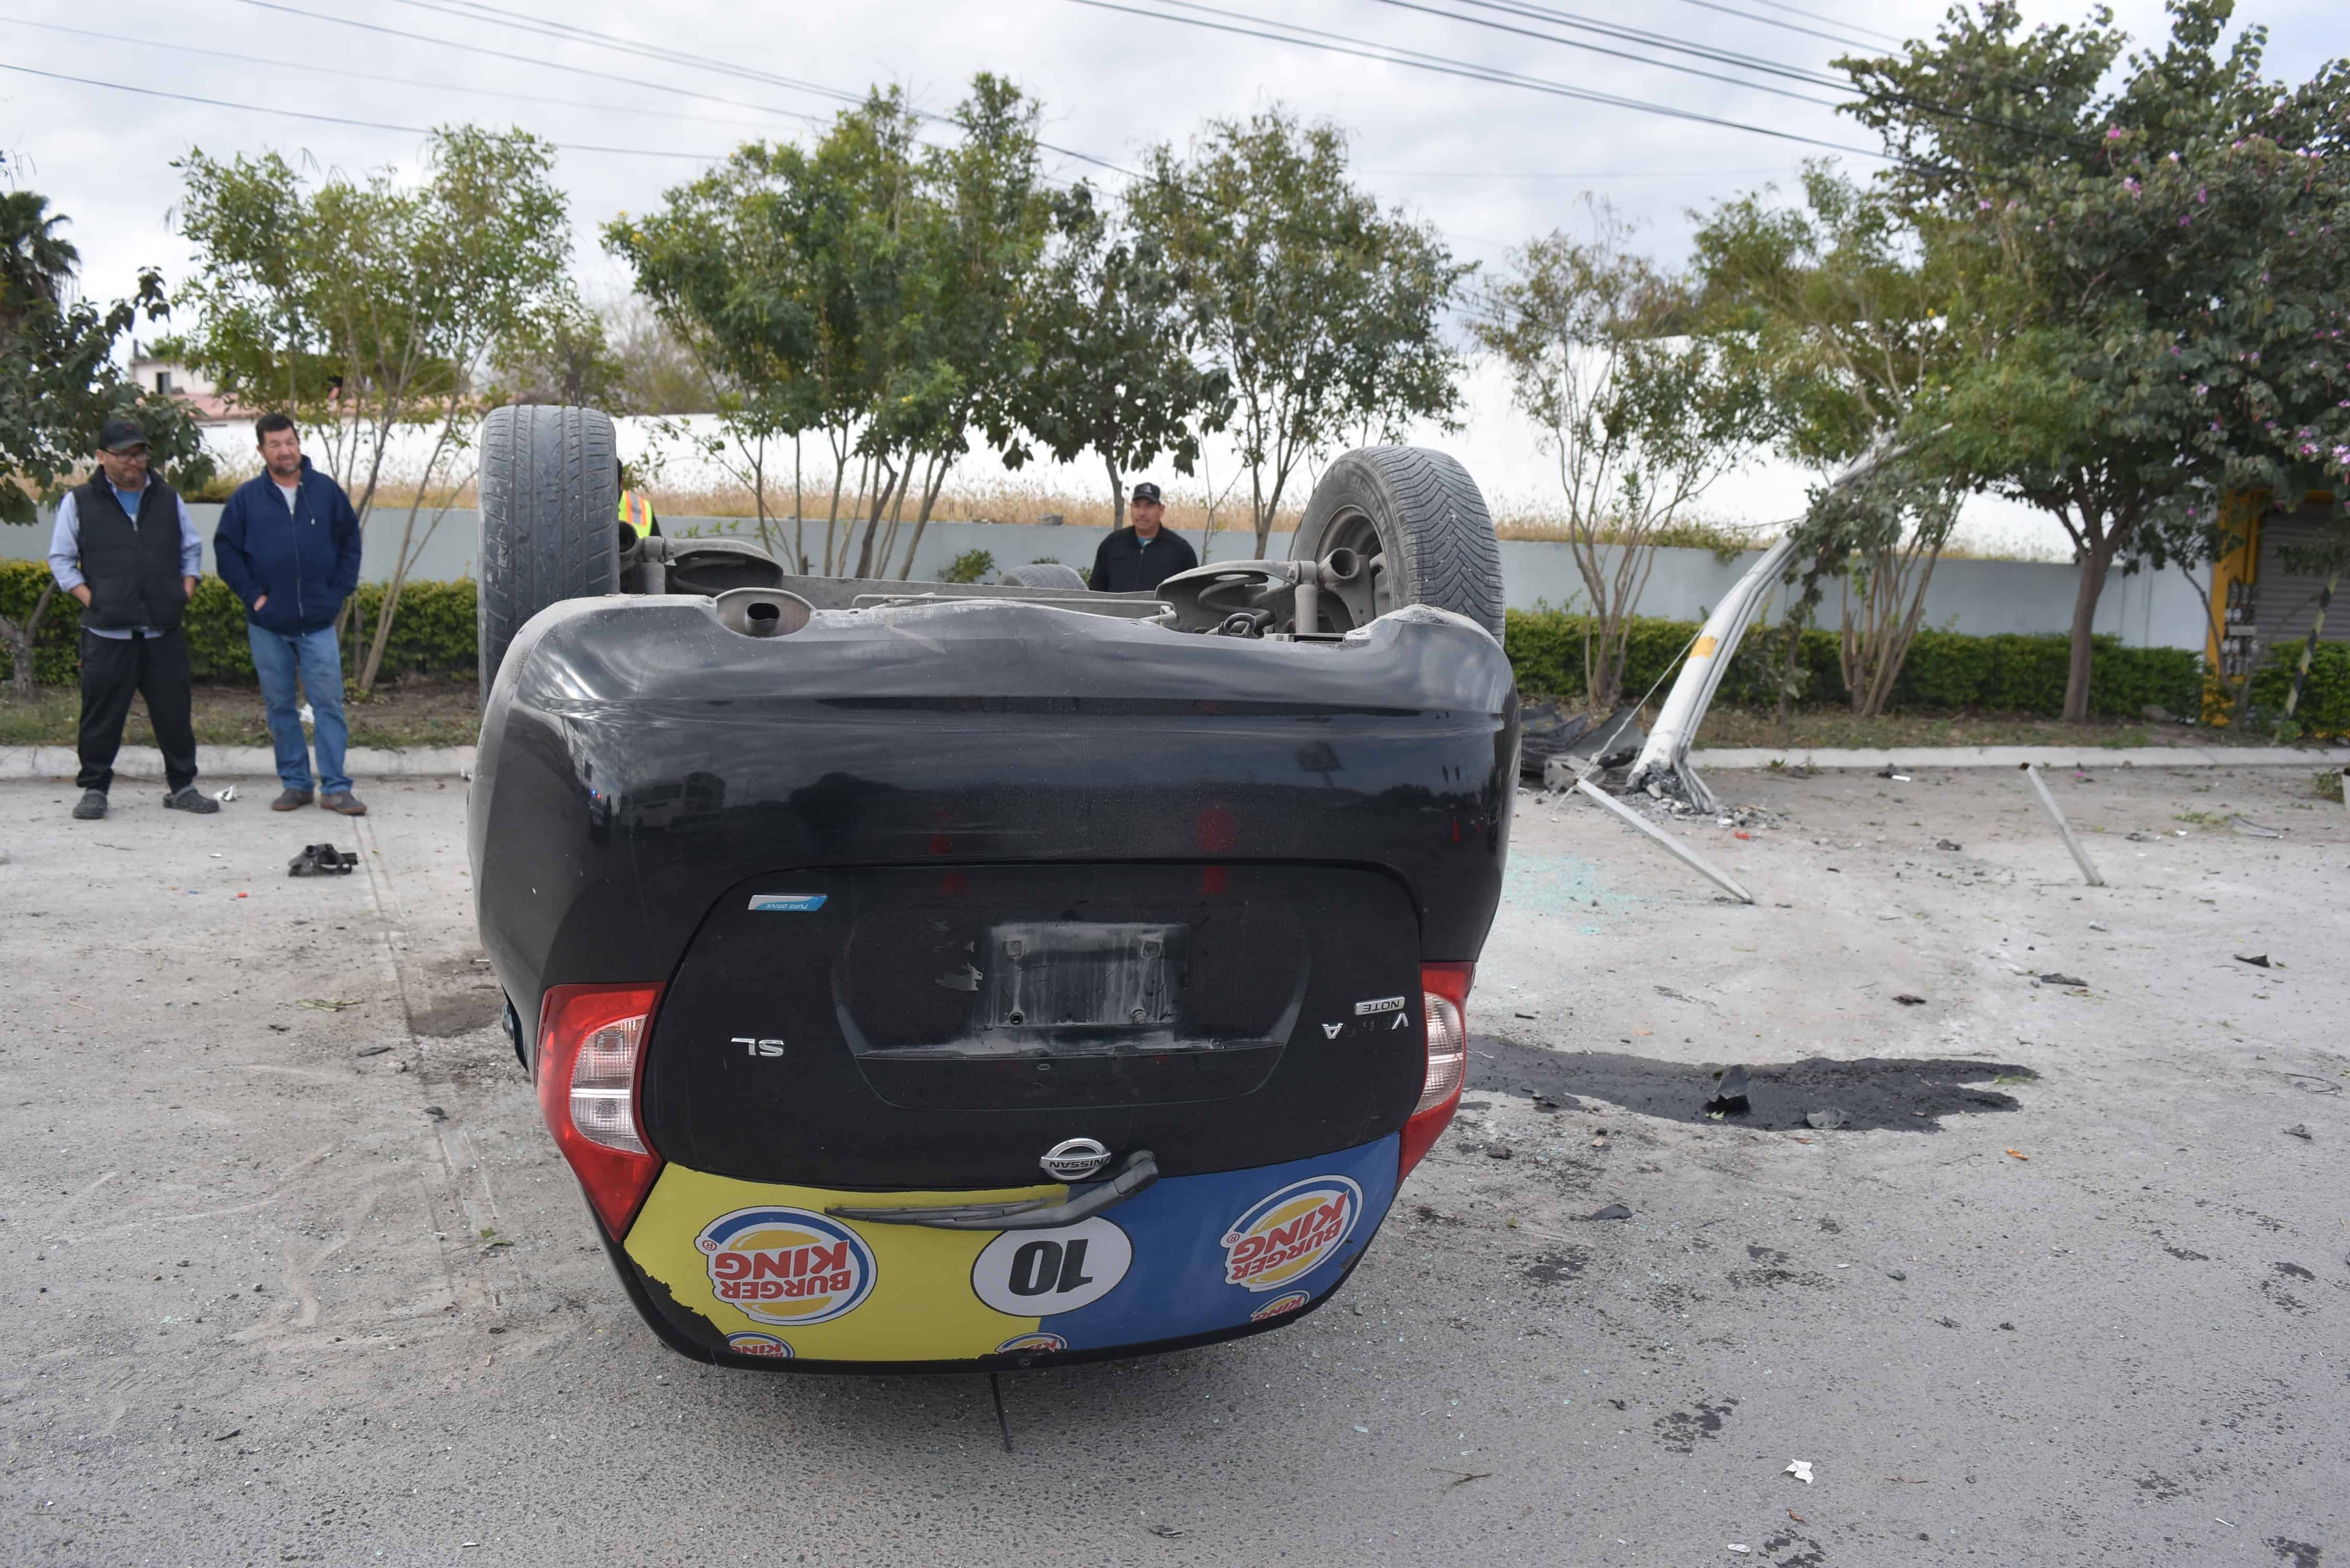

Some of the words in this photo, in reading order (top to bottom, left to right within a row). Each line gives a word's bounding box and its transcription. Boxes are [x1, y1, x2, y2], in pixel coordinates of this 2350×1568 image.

[1363, 1000, 1400, 1012] NOTE
[731, 1037, 784, 1057] SL
[1049, 1158, 1104, 1168] NISSAN
[1231, 1191, 1347, 1264] KING
[715, 1240, 849, 1281] KING
[1231, 1217, 1343, 1280] BURGER
[720, 1270, 851, 1299] BURGER
[1008, 1238, 1093, 1296] 10
